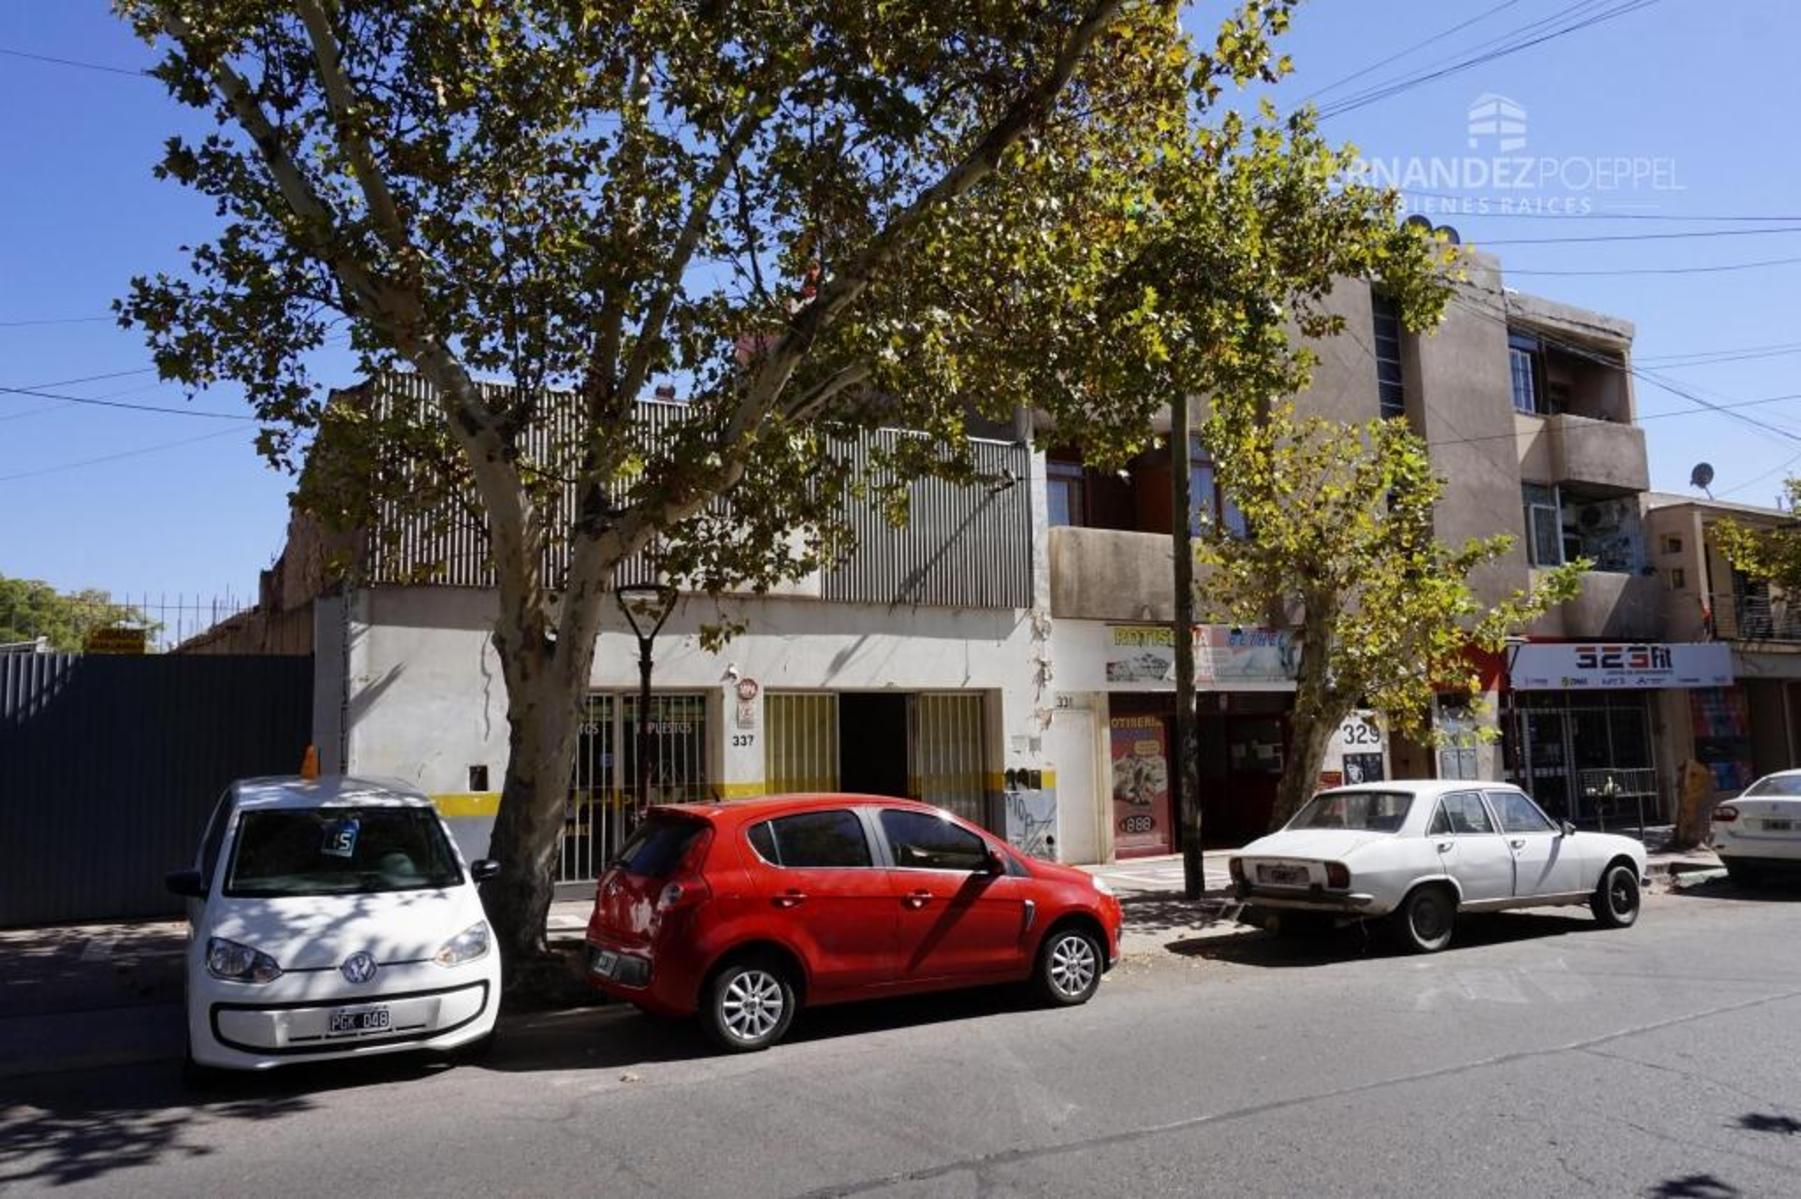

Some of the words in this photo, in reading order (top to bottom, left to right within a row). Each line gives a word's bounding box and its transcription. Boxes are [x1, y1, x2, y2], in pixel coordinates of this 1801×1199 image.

[1113, 627, 1209, 646] ROTISIA
[732, 735, 754, 746] 337
[1343, 723, 1380, 745] 329
